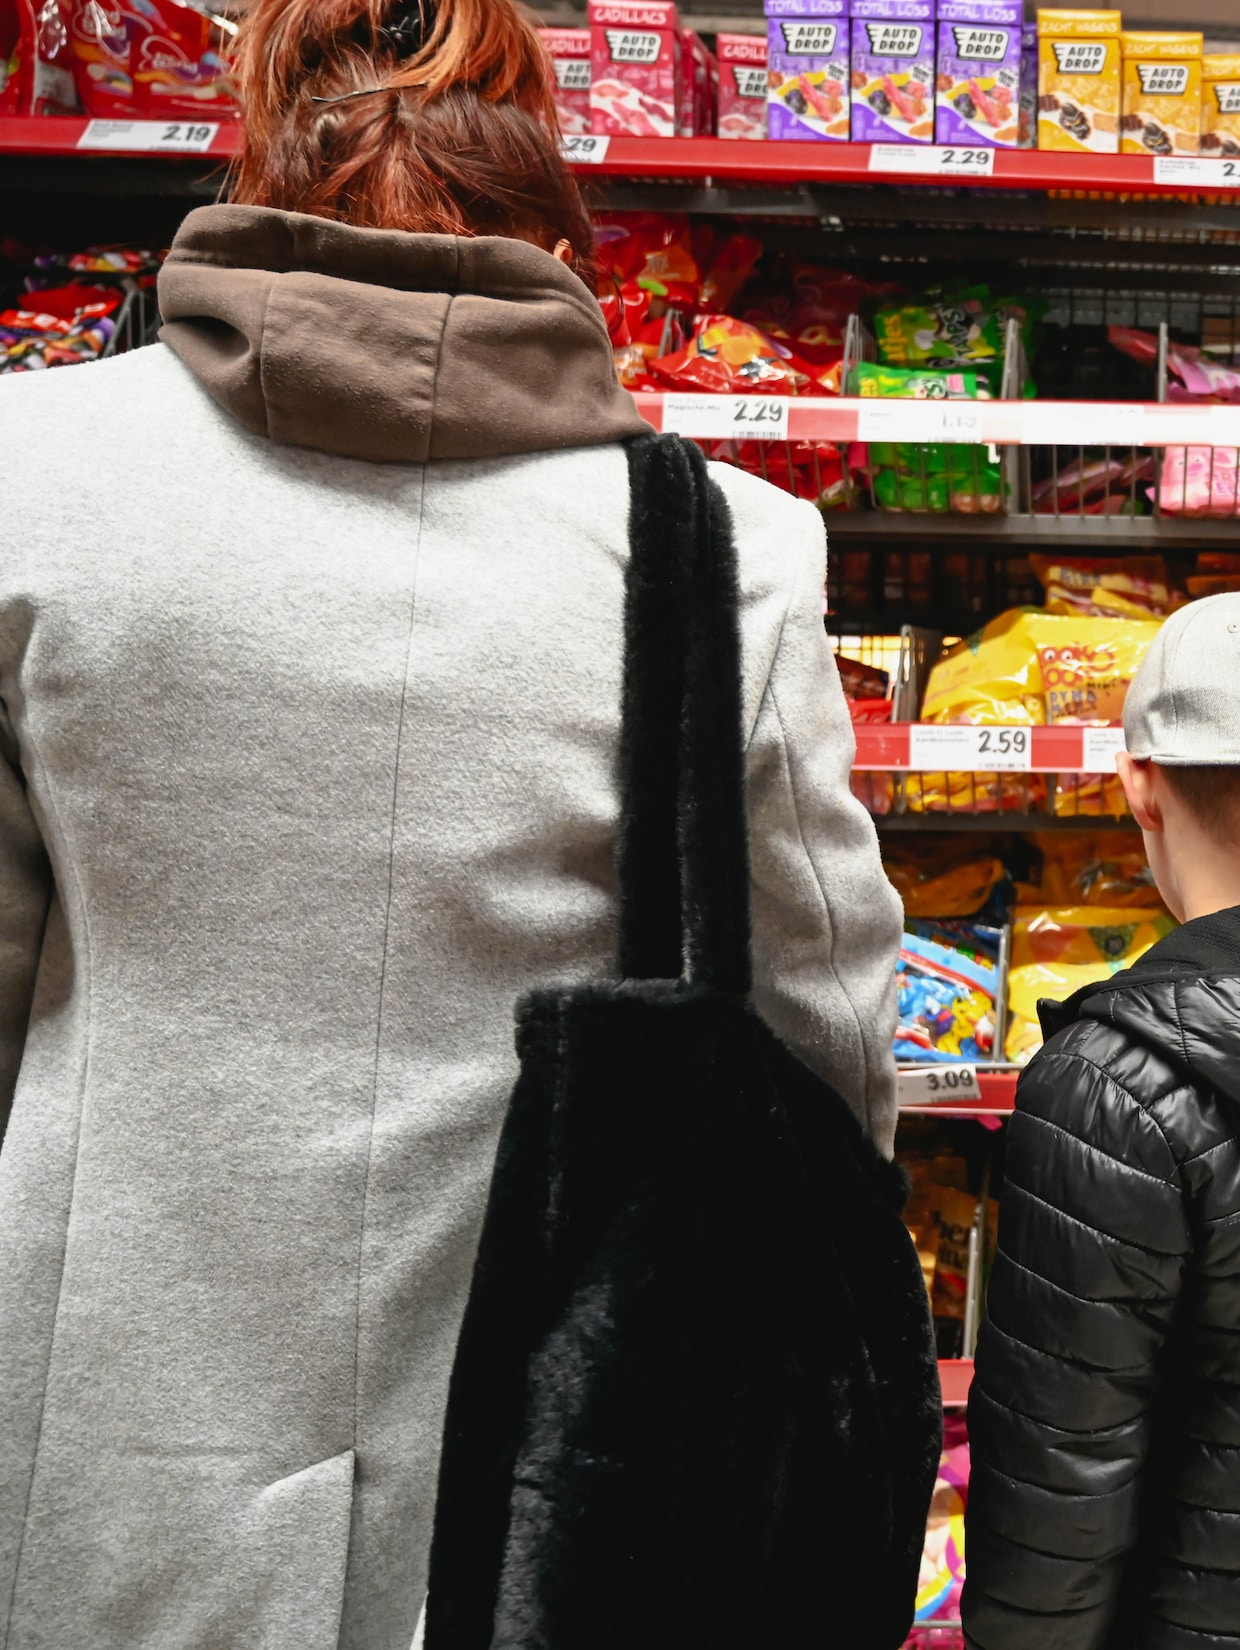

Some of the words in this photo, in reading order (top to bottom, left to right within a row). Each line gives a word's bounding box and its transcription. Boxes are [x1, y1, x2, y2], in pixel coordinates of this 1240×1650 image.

[767, 1, 806, 13] TOTAL
[810, 1, 843, 13] LOSS
[853, 2, 893, 14] TOTAL
[896, 4, 930, 17] LOSS
[939, 4, 979, 18] TOTAL
[984, 8, 1017, 21] LOSS
[593, 8, 667, 25] CADILLACS
[797, 27, 832, 38] AUTO
[882, 28, 917, 39] AUTO
[968, 32, 1004, 43] AUTO
[621, 35, 657, 46] AUTO
[794, 40, 830, 50] DROP
[879, 41, 914, 51] DROP
[618, 48, 654, 58] DROP
[723, 44, 768, 59] CADILL
[965, 45, 1001, 56] DROP
[1068, 46, 1102, 57] AUTO
[567, 65, 591, 73] AUT
[1065, 58, 1100, 69] DROP
[747, 72, 766, 82] AU
[1151, 68, 1184, 79] AUTO
[564, 75, 589, 85] DRO
[1149, 80, 1182, 90] DROP
[161, 126, 210, 142] 2.19
[567, 138, 598, 152] 29
[941, 150, 990, 165] 2.29
[733, 400, 783, 423] 2.29
[978, 731, 1026, 752] 2.59
[926, 1069, 974, 1090] 3.09
